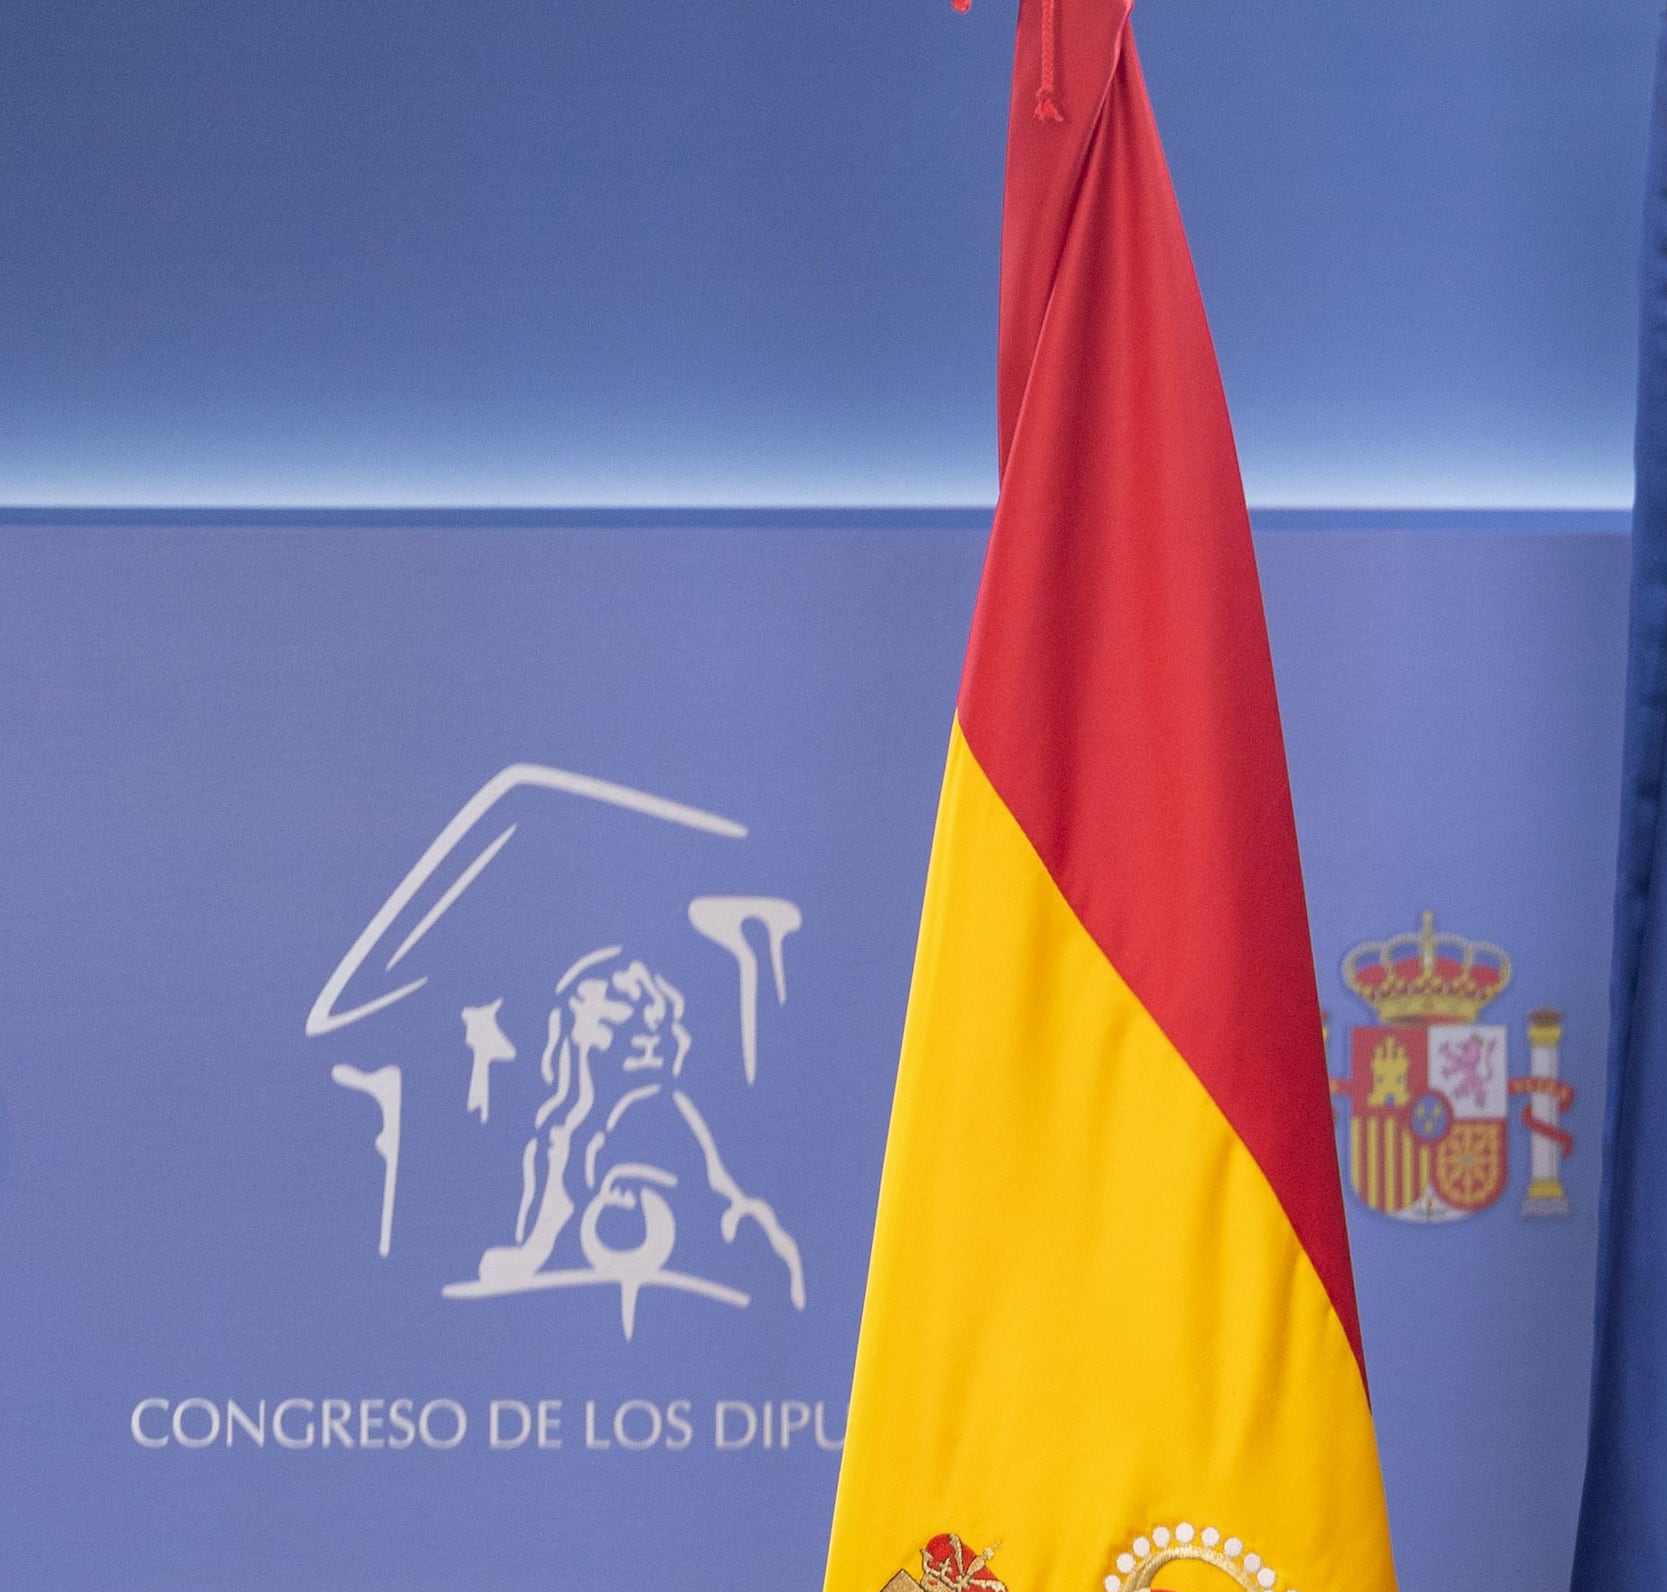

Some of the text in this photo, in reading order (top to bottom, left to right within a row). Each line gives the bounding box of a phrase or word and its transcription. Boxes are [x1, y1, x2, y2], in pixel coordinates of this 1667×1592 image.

[131, 1397, 467, 1449] CONGRESO
[489, 1400, 563, 1450] DE
[585, 1400, 692, 1450] LOS
